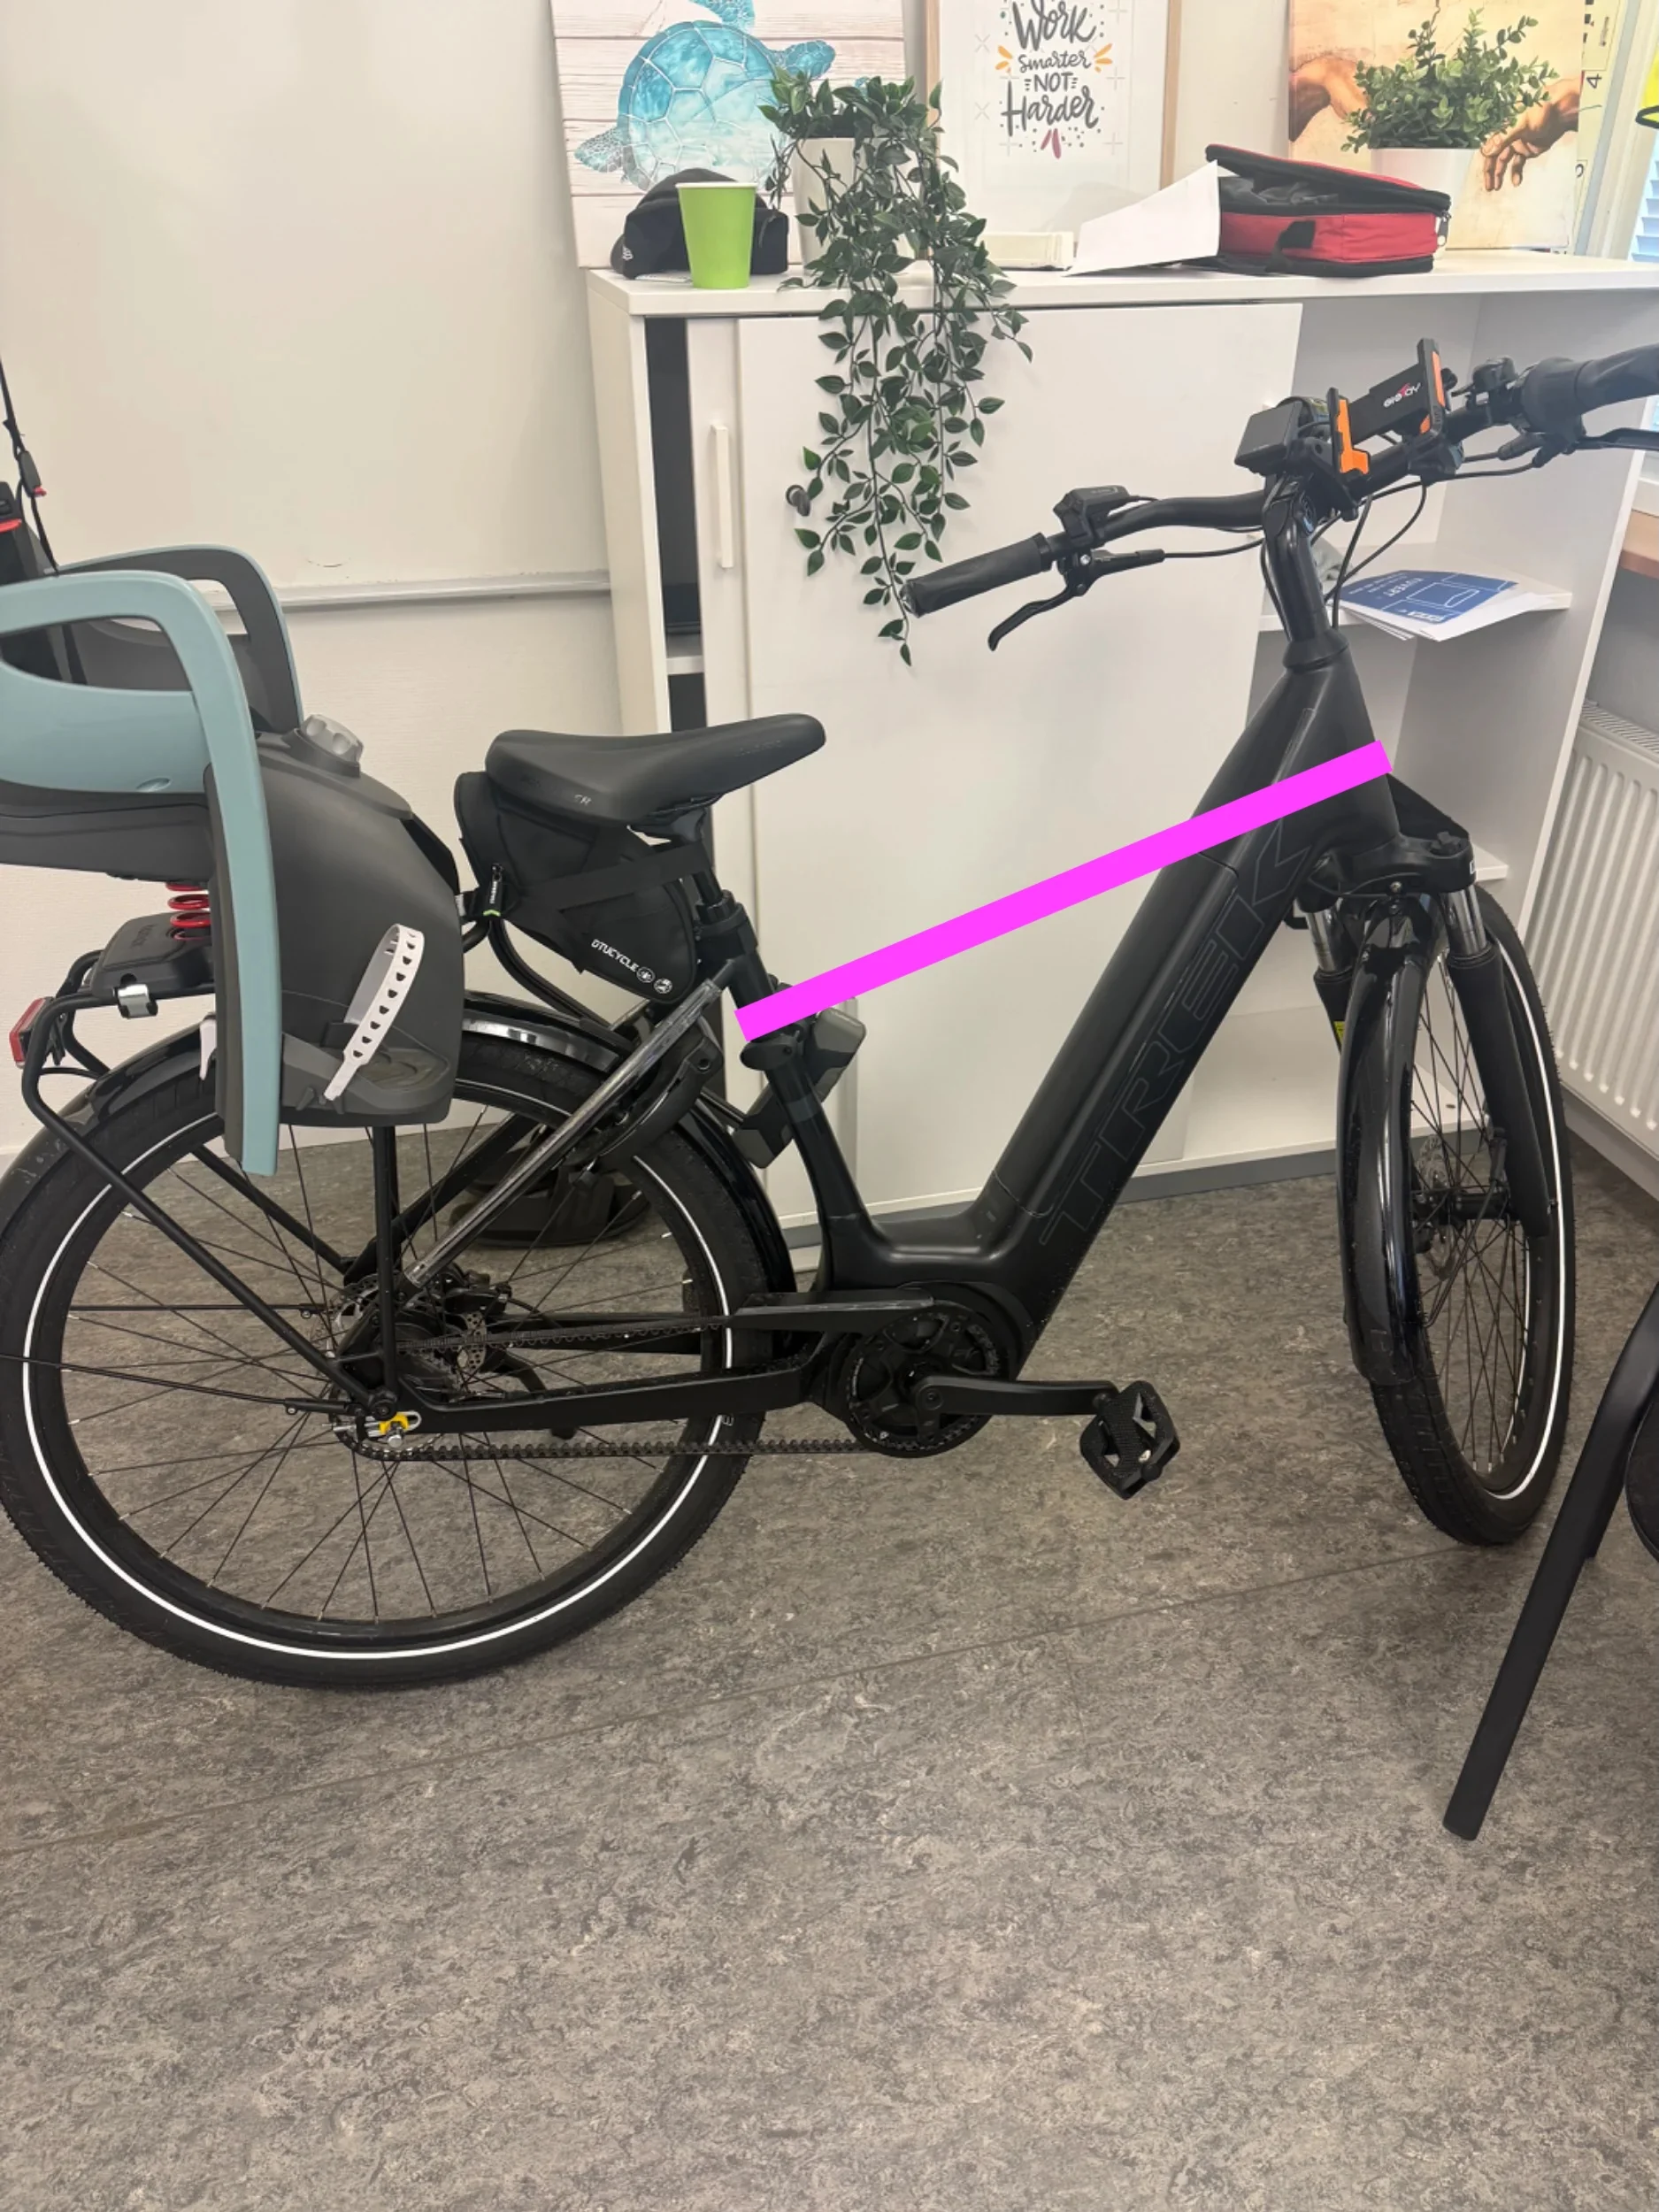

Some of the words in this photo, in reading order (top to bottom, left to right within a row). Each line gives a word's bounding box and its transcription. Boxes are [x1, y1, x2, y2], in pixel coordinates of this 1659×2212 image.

[1012, 0, 1096, 50] Work
[1033, 72, 1074, 92] NOT
[1001, 81, 1099, 136] Harder
[1039, 708, 1316, 1244] TREK
